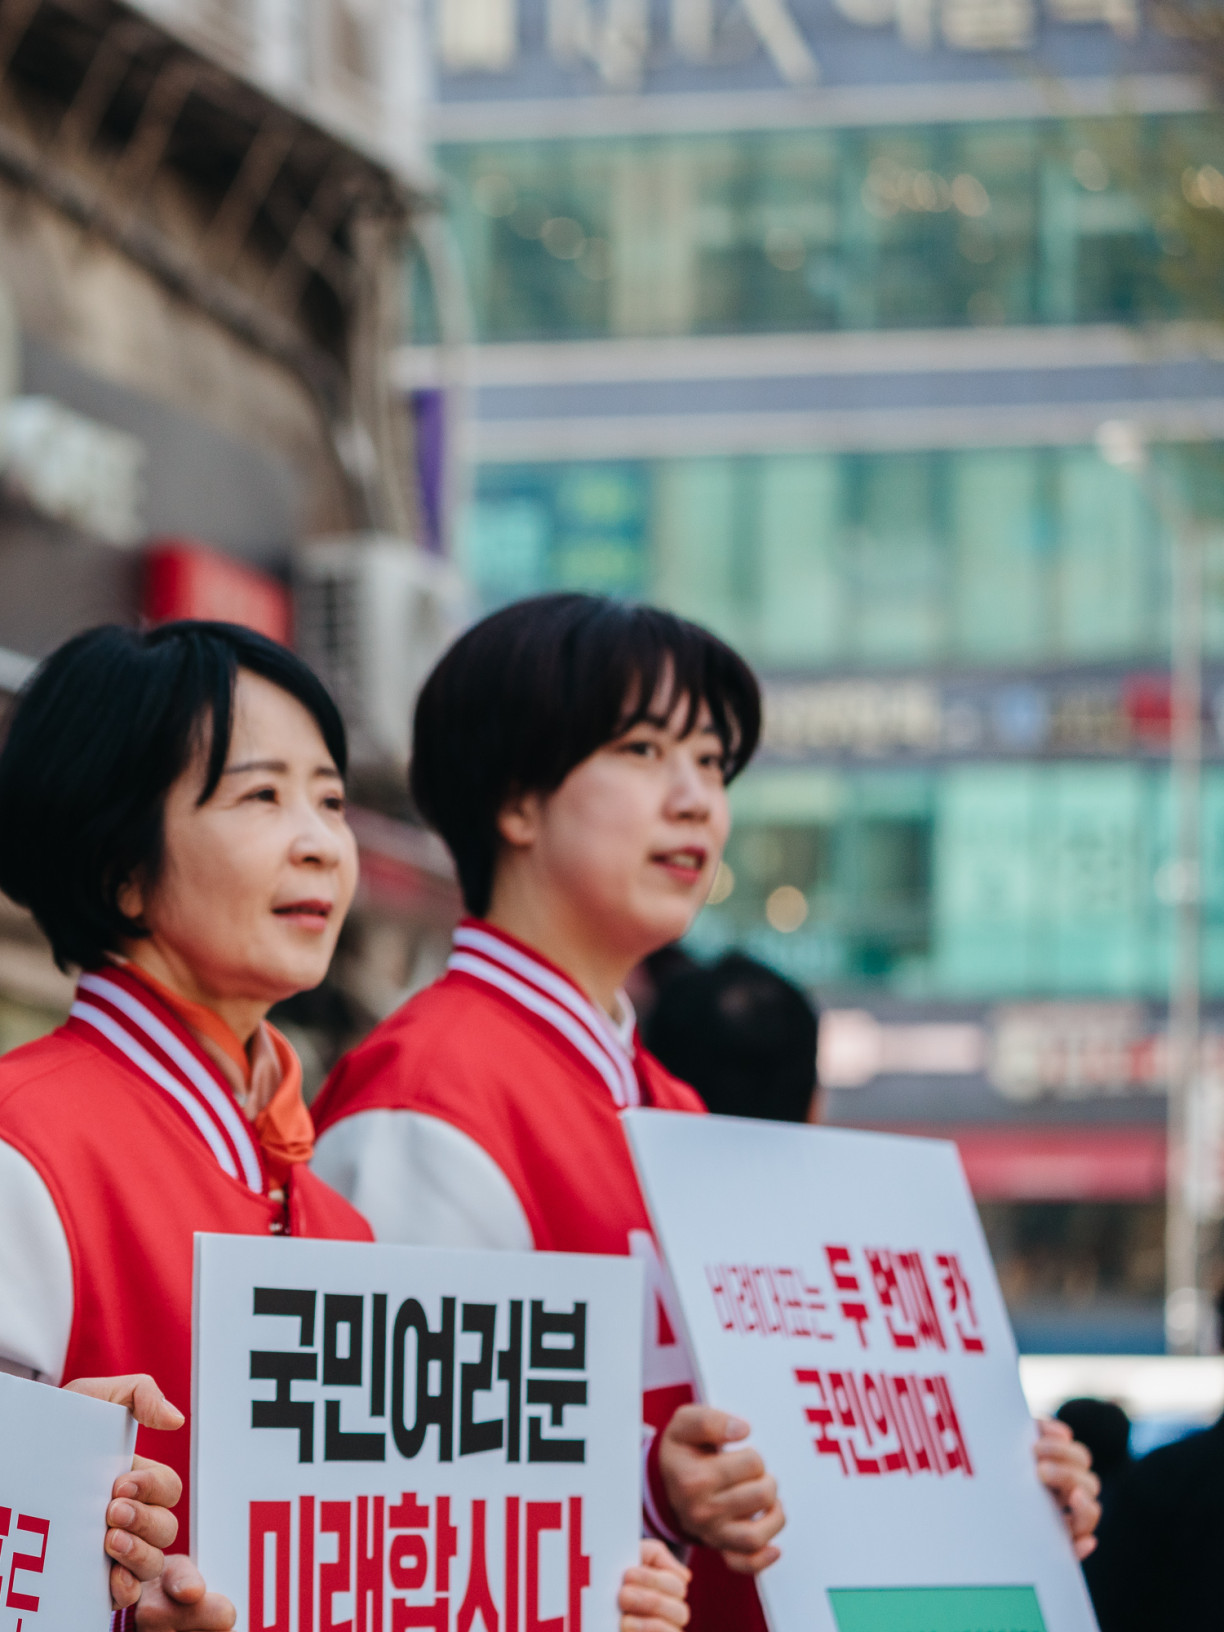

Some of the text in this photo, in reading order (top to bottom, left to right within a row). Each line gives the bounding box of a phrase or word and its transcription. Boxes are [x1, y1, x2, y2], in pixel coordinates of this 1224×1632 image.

[705, 1244, 986, 1356] 비례대표는 두 번째 칸
[250, 1287, 588, 1464] 국민여러분
[792, 1367, 975, 1478] 국민의미래
[249, 1492, 591, 1632] 미래합시다
